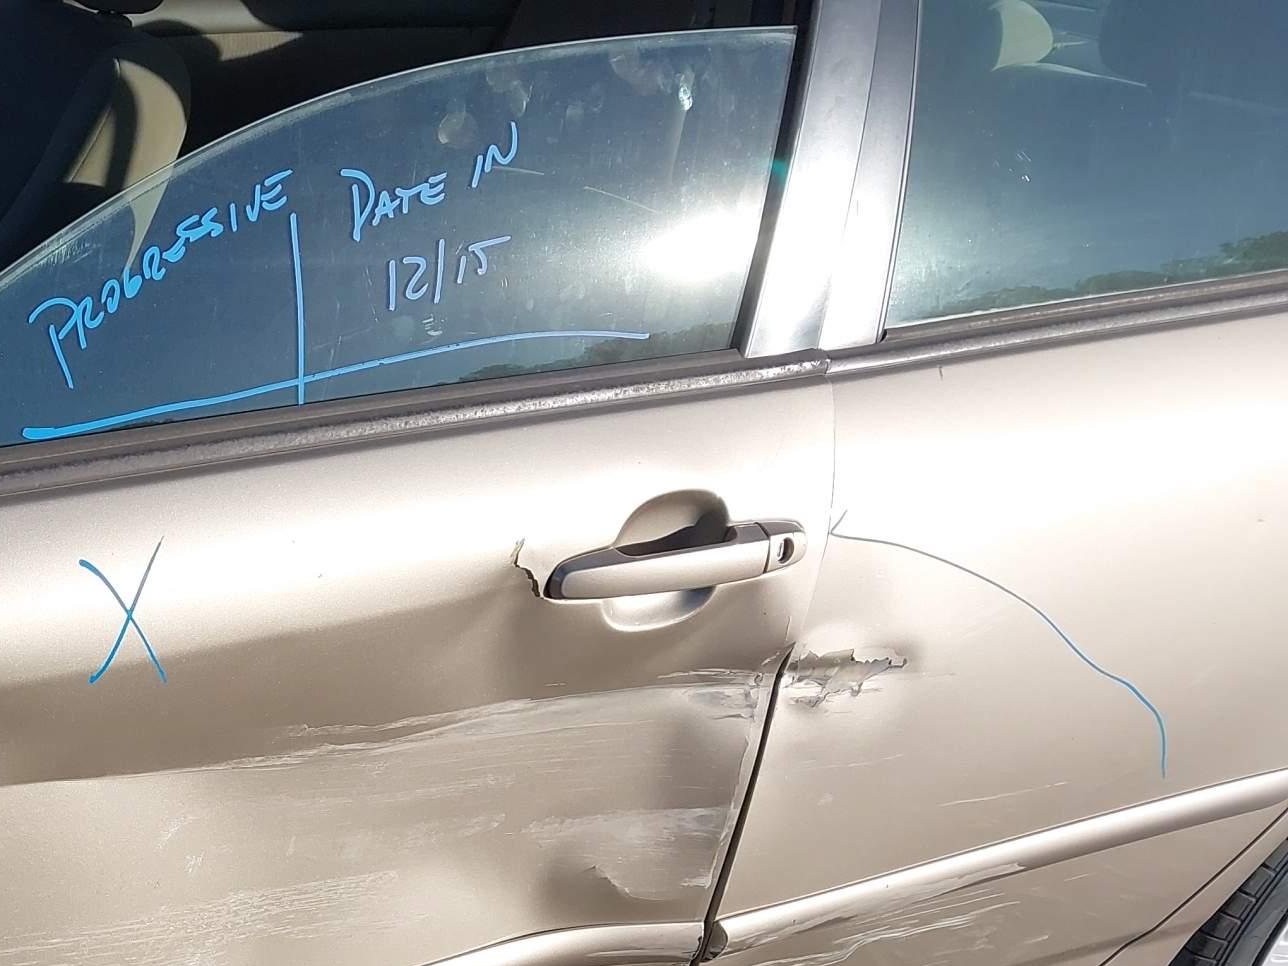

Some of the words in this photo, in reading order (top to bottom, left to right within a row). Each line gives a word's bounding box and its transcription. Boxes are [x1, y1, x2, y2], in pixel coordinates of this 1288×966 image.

[339, 168, 448, 242] DATE
[470, 120, 520, 188] IN
[27, 167, 295, 390] PROGRESSIVE
[386, 235, 511, 312] 12/15
